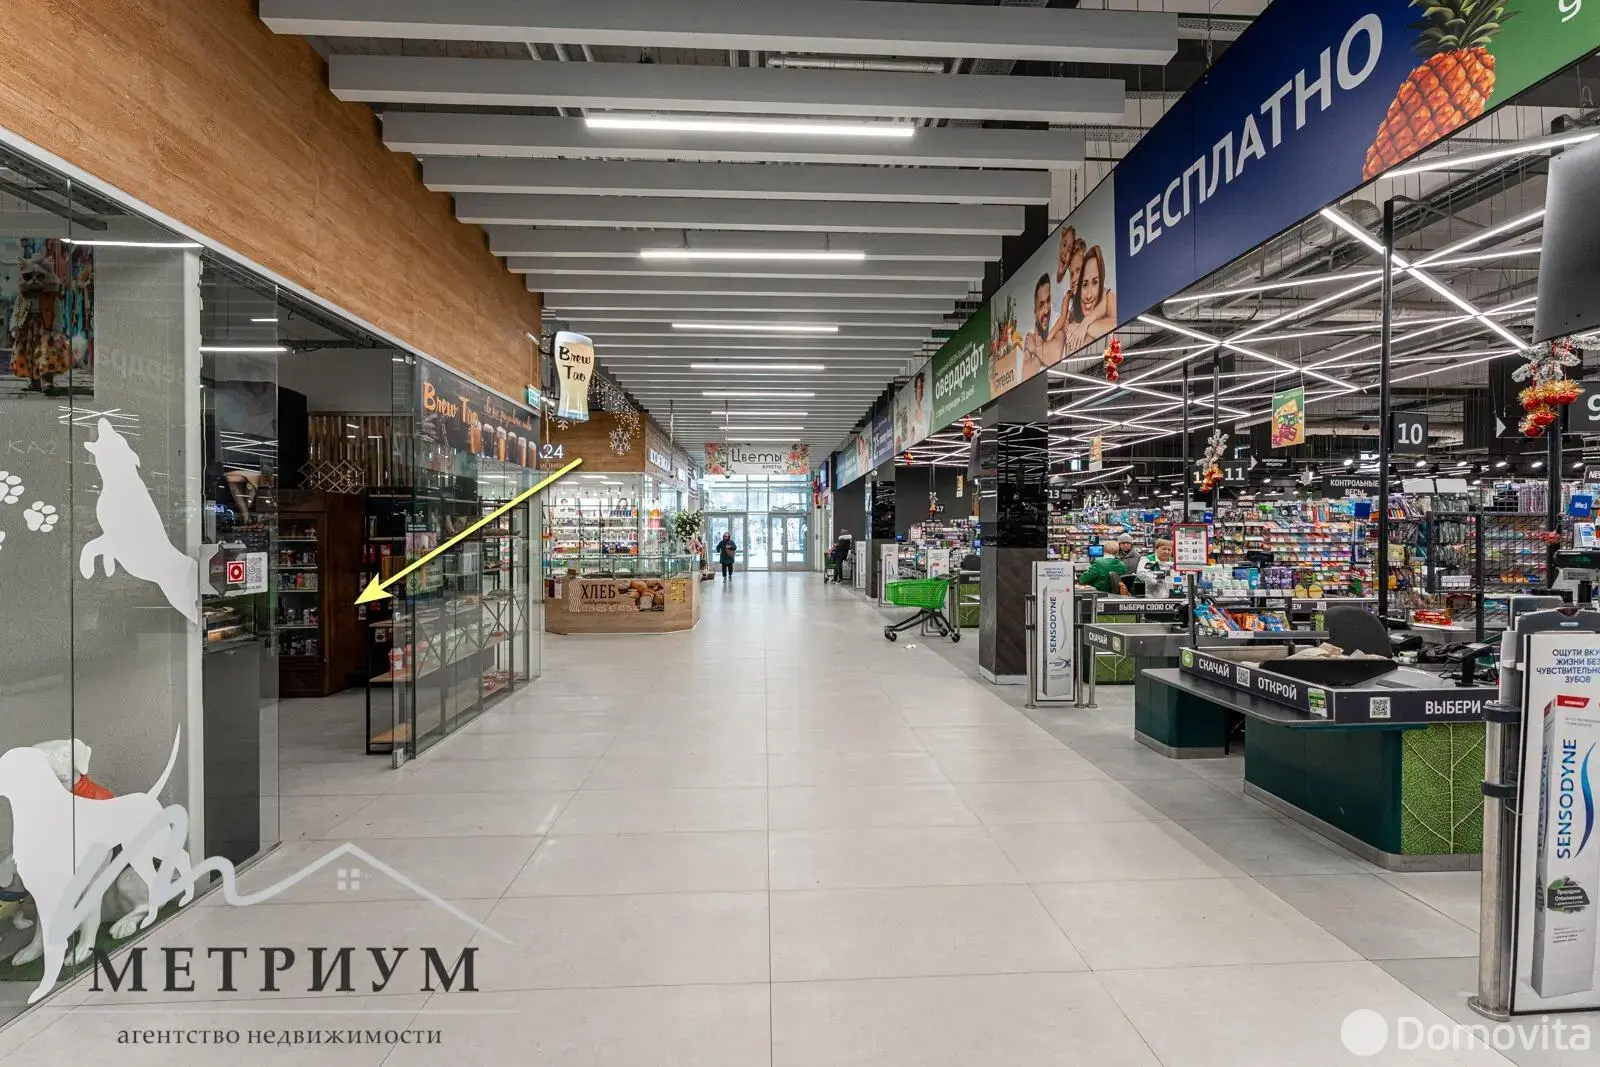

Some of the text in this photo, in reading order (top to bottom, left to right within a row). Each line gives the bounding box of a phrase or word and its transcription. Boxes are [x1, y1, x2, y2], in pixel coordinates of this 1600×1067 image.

[1129, 13, 1383, 257] БЕСПЛАТНО
[559, 346, 591, 365] Brew
[935, 342, 985, 399] овердрафт
[423, 381, 457, 418] Brew
[1587, 393, 1600, 421] 9
[1398, 422, 1423, 444] 10
[731, 448, 782, 463] Цветы
[1224, 467, 1245, 481] 11
[1588, 471, 1600, 479] NE
[1330, 479, 1380, 487] КОНТРОЛЬНЫЕ
[1048, 489, 1060, 499] 13
[1344, 488, 1364, 496] ВЕСЫ
[581, 584, 616, 599] ХЛЕБ
[1119, 602, 1176, 612] ВЫБЕРИ СВОЮ СК
[1088, 631, 1108, 646] СКАЧАЙ
[1552, 648, 1583, 657] ОЩУТИ
[1198, 658, 1230, 678] СКАЧАЙ
[1556, 658, 1585, 666] ЖИЗНИ
[1564, 675, 1591, 684] ЗУБОВ
[1257, 676, 1297, 700] ОТКРОЙ
[1425, 700, 1481, 715] ВЫБЕРИ
[1557, 739, 1577, 859] SENSODYNE
